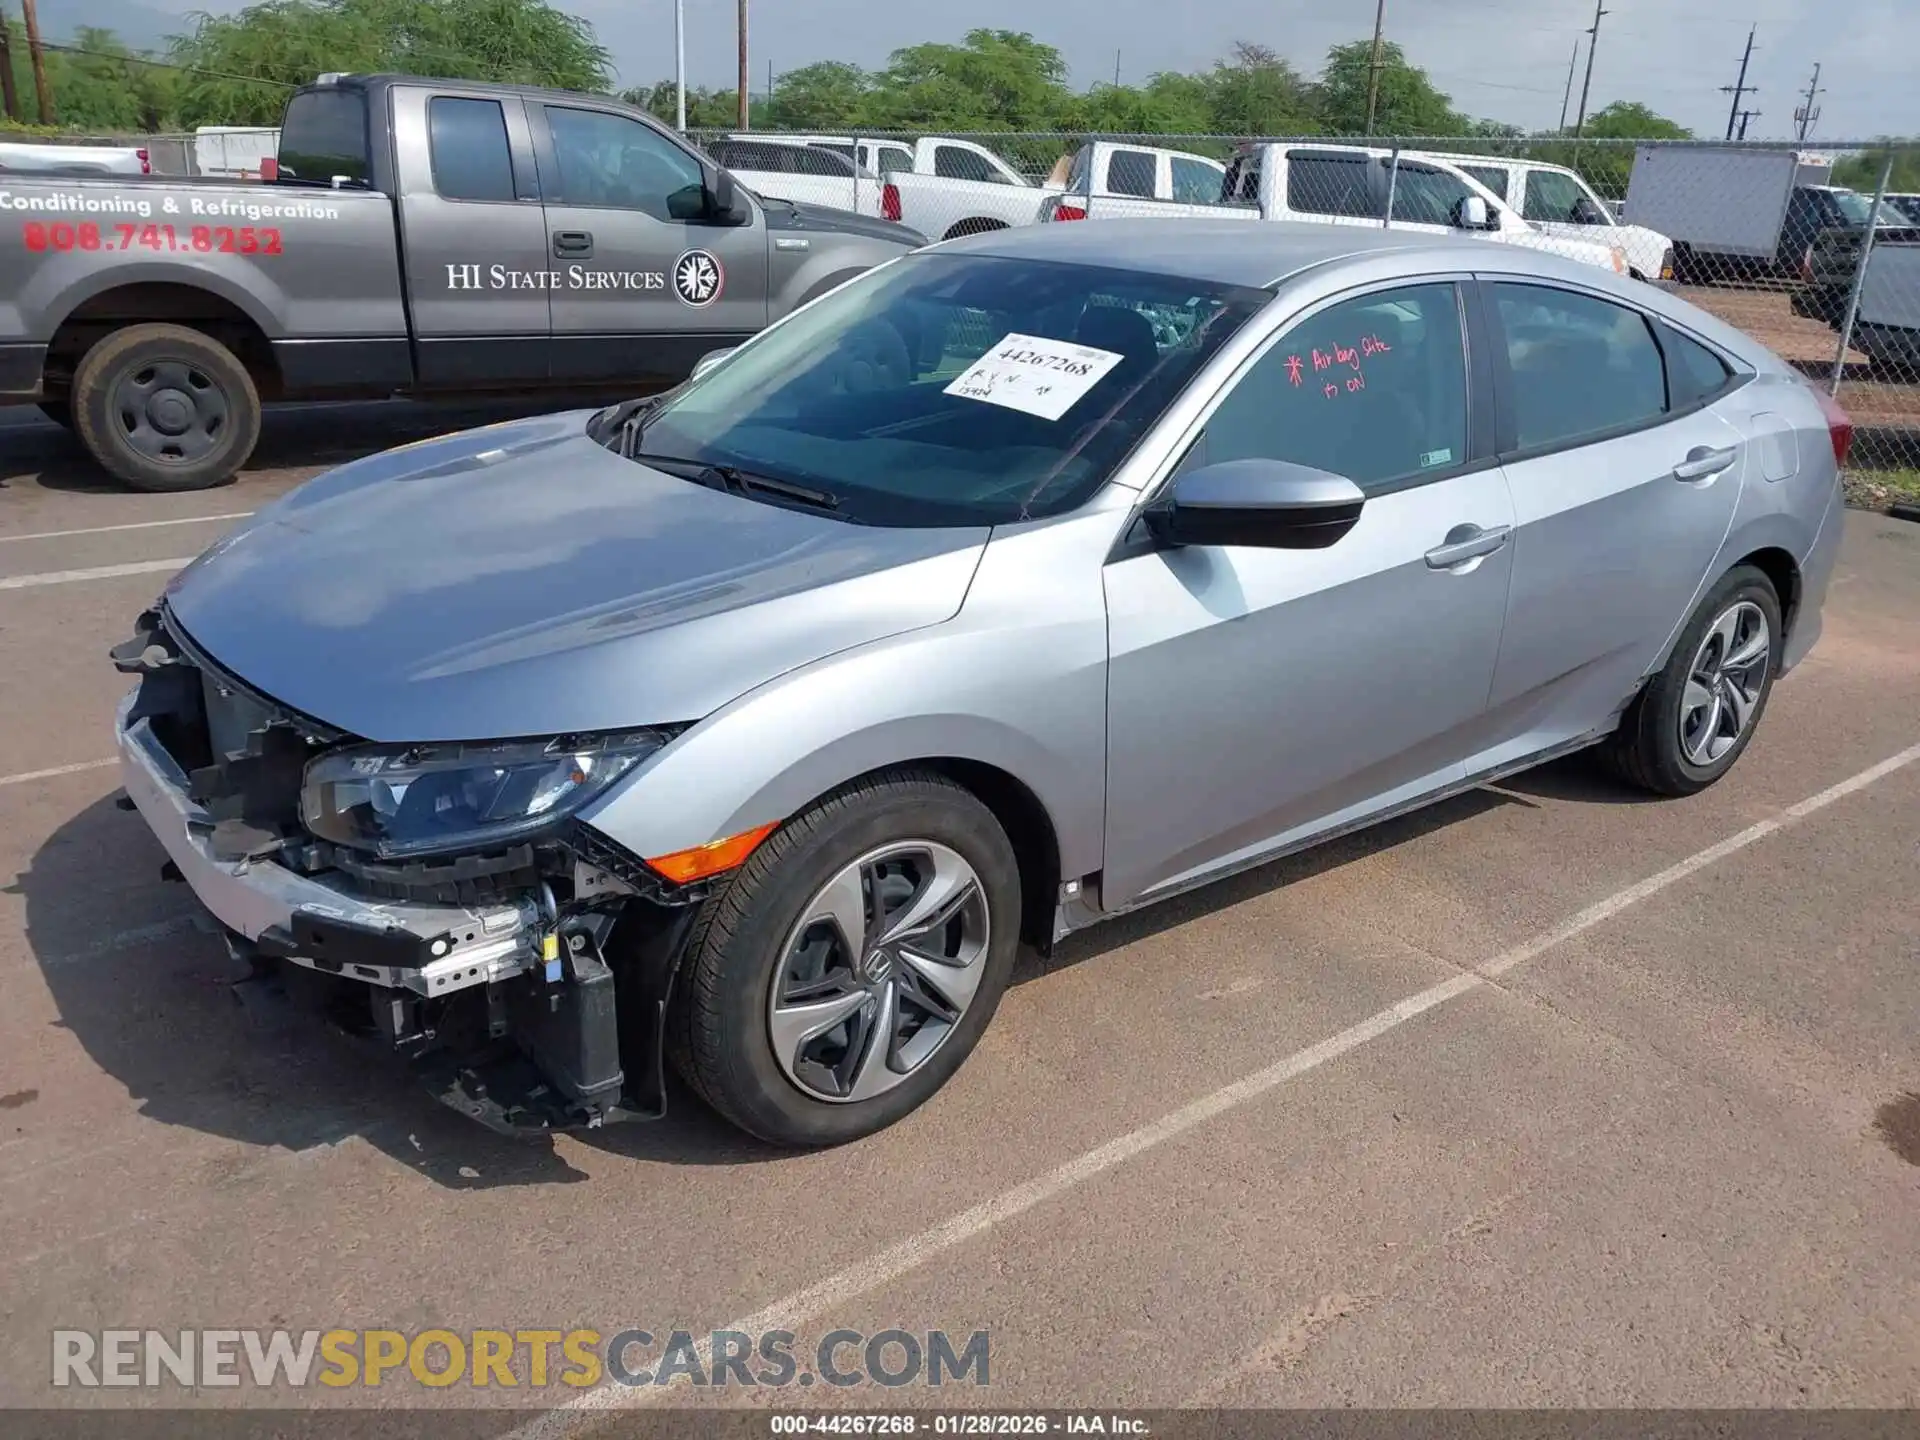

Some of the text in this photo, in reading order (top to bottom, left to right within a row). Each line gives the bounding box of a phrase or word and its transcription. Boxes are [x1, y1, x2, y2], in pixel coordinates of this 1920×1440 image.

[0, 191, 339, 220] Conditioning & Refrigeration
[23, 221, 283, 255] 808.741.8252
[445, 264, 483, 289] HI
[1000, 348, 1094, 376] 44267268
[1312, 348, 1332, 371] Air
